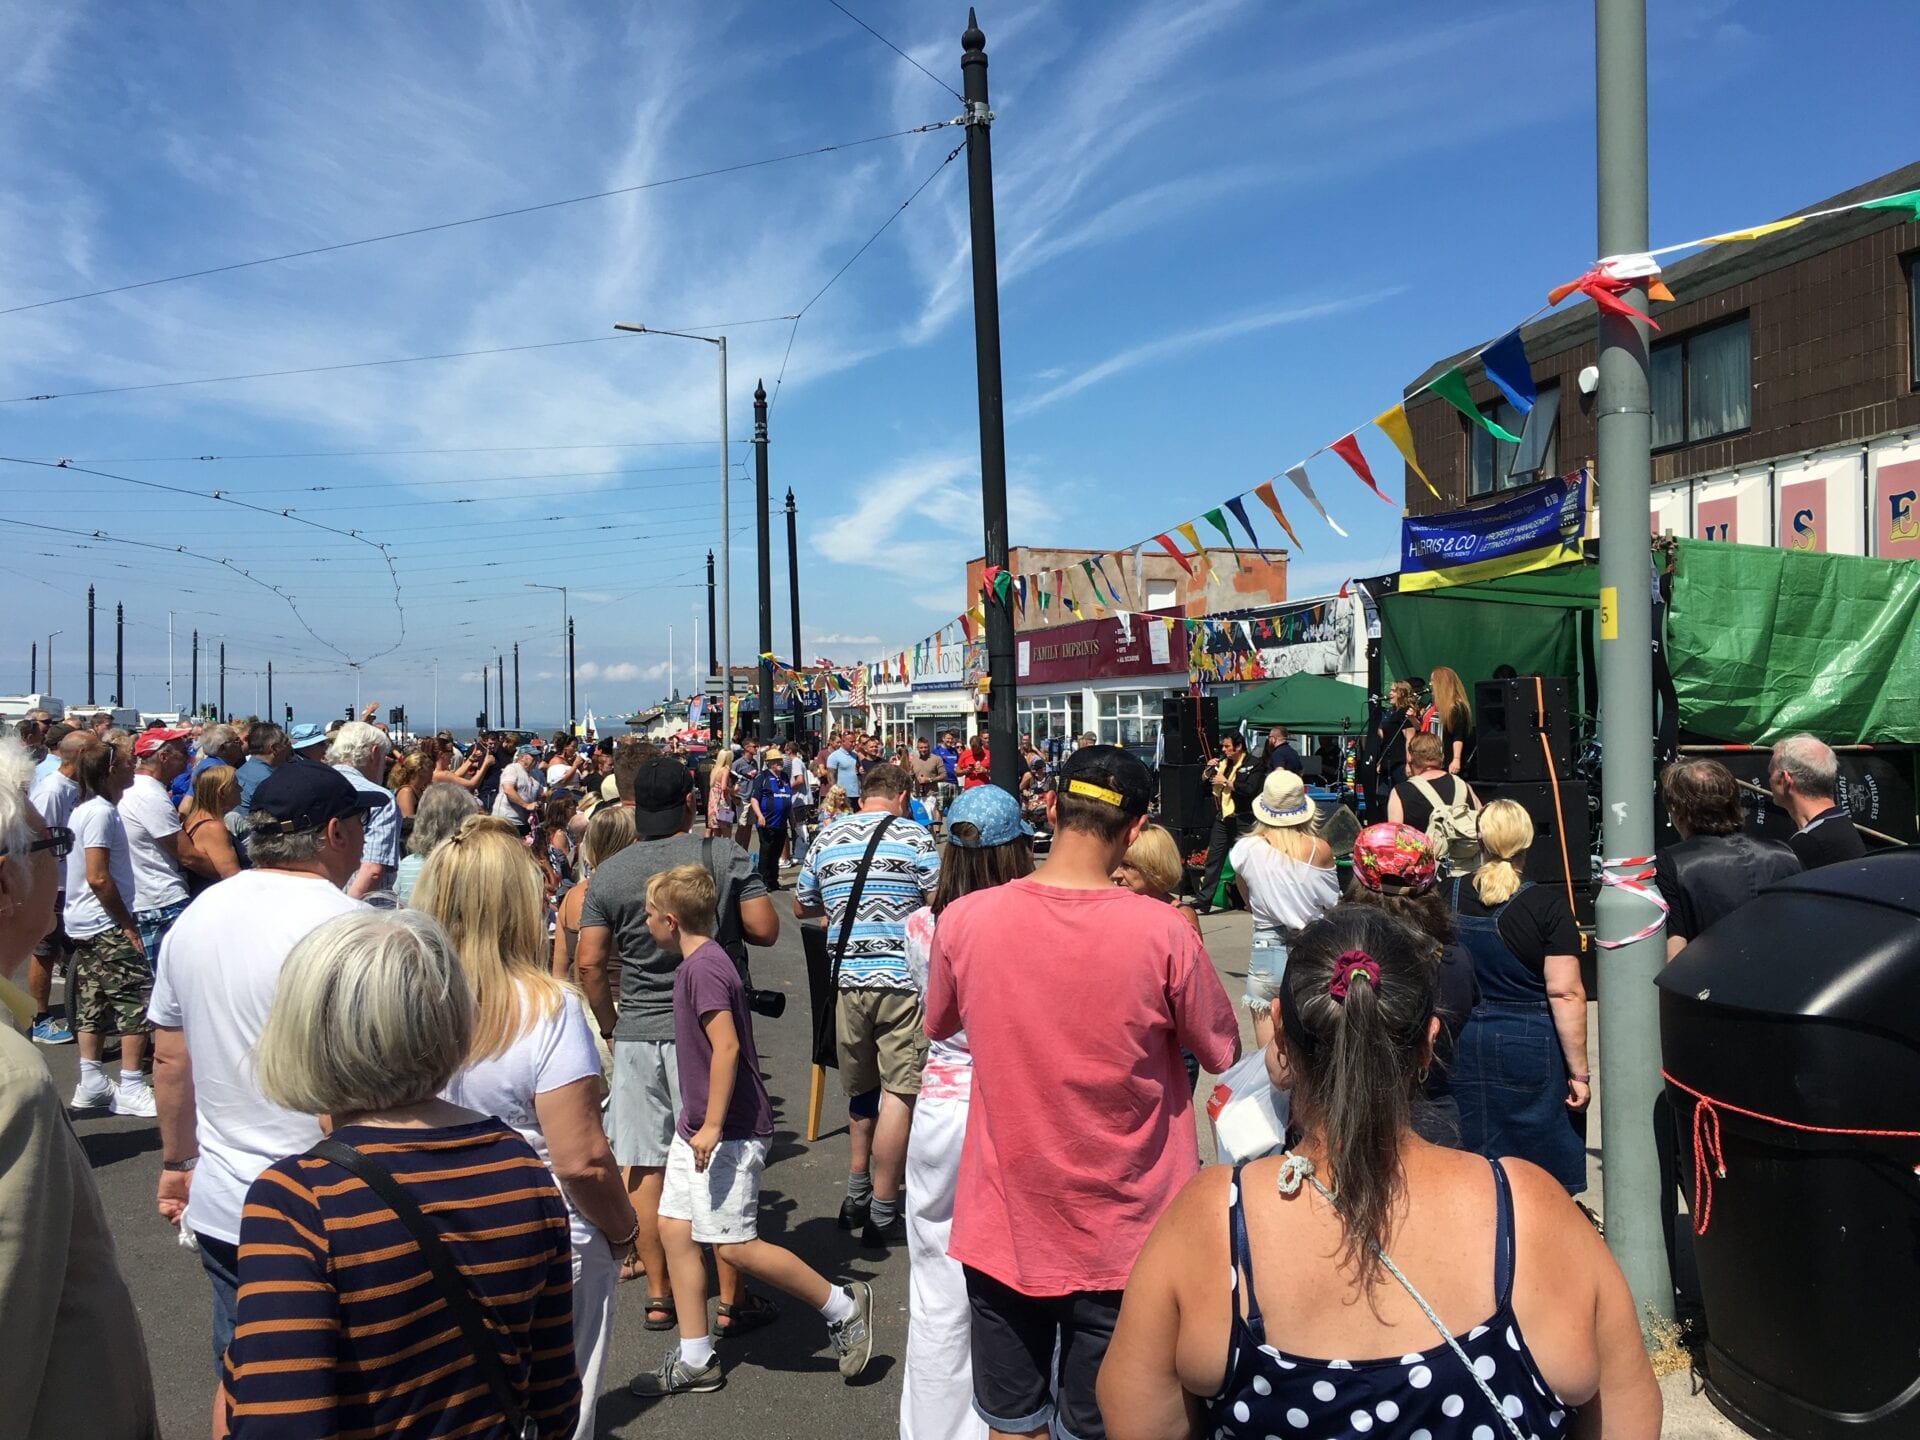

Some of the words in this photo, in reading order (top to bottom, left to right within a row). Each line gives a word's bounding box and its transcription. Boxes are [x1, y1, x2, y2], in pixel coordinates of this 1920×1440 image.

[1443, 537, 1454, 552] &
[1455, 534, 1477, 550] CO
[1601, 607, 1609, 624] 5
[1033, 644, 1058, 661] FAMILY
[1061, 639, 1100, 657] IMPRINTS
[1864, 774, 1880, 820] BUILDERS
